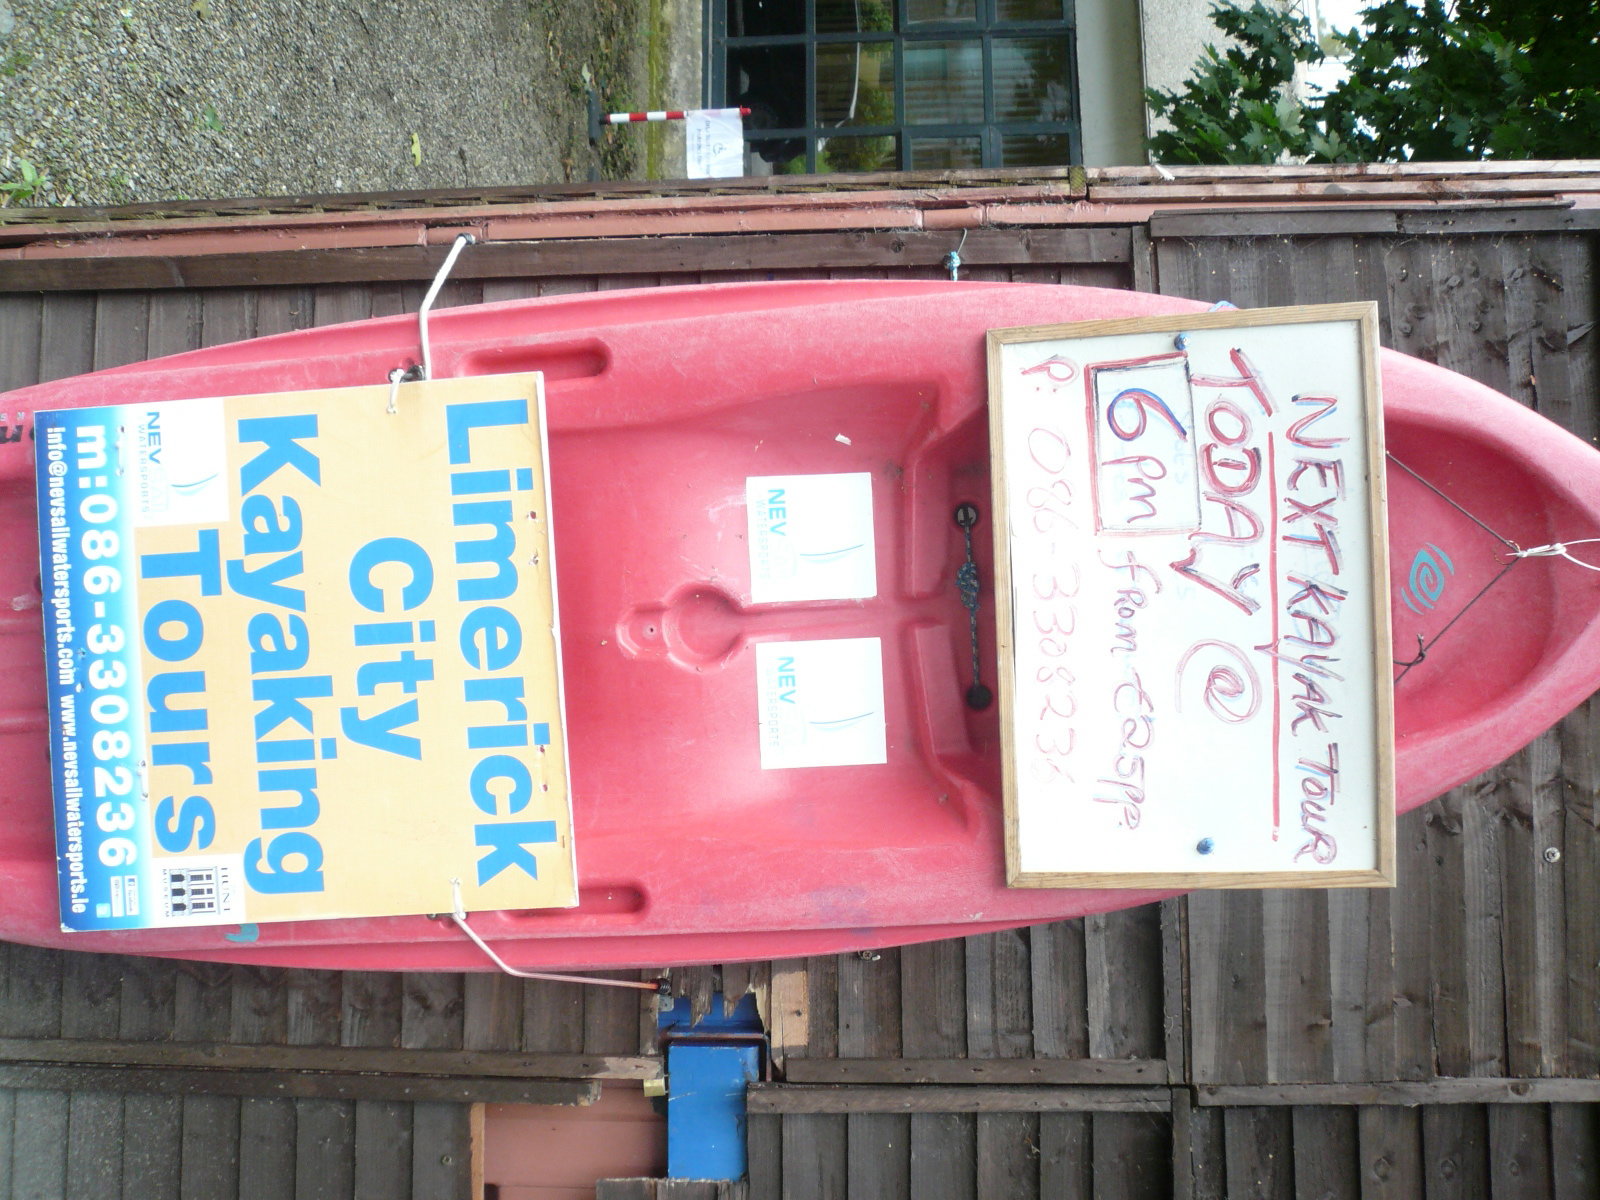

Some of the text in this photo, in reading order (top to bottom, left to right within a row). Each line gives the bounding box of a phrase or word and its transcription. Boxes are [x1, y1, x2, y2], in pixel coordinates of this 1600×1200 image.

[226, 413, 337, 895] Kayaking
[341, 537, 436, 761] City
[446, 399, 557, 886] Limerick
[1169, 347, 1280, 725] TODAY @
[1254, 569, 1349, 738] KAYAK
[1282, 393, 1350, 576] NEXT
[47, 427, 89, 913] info@nevsailwatersports.com www.nevsailwatersports.ie
[140, 528, 222, 853] Tours
